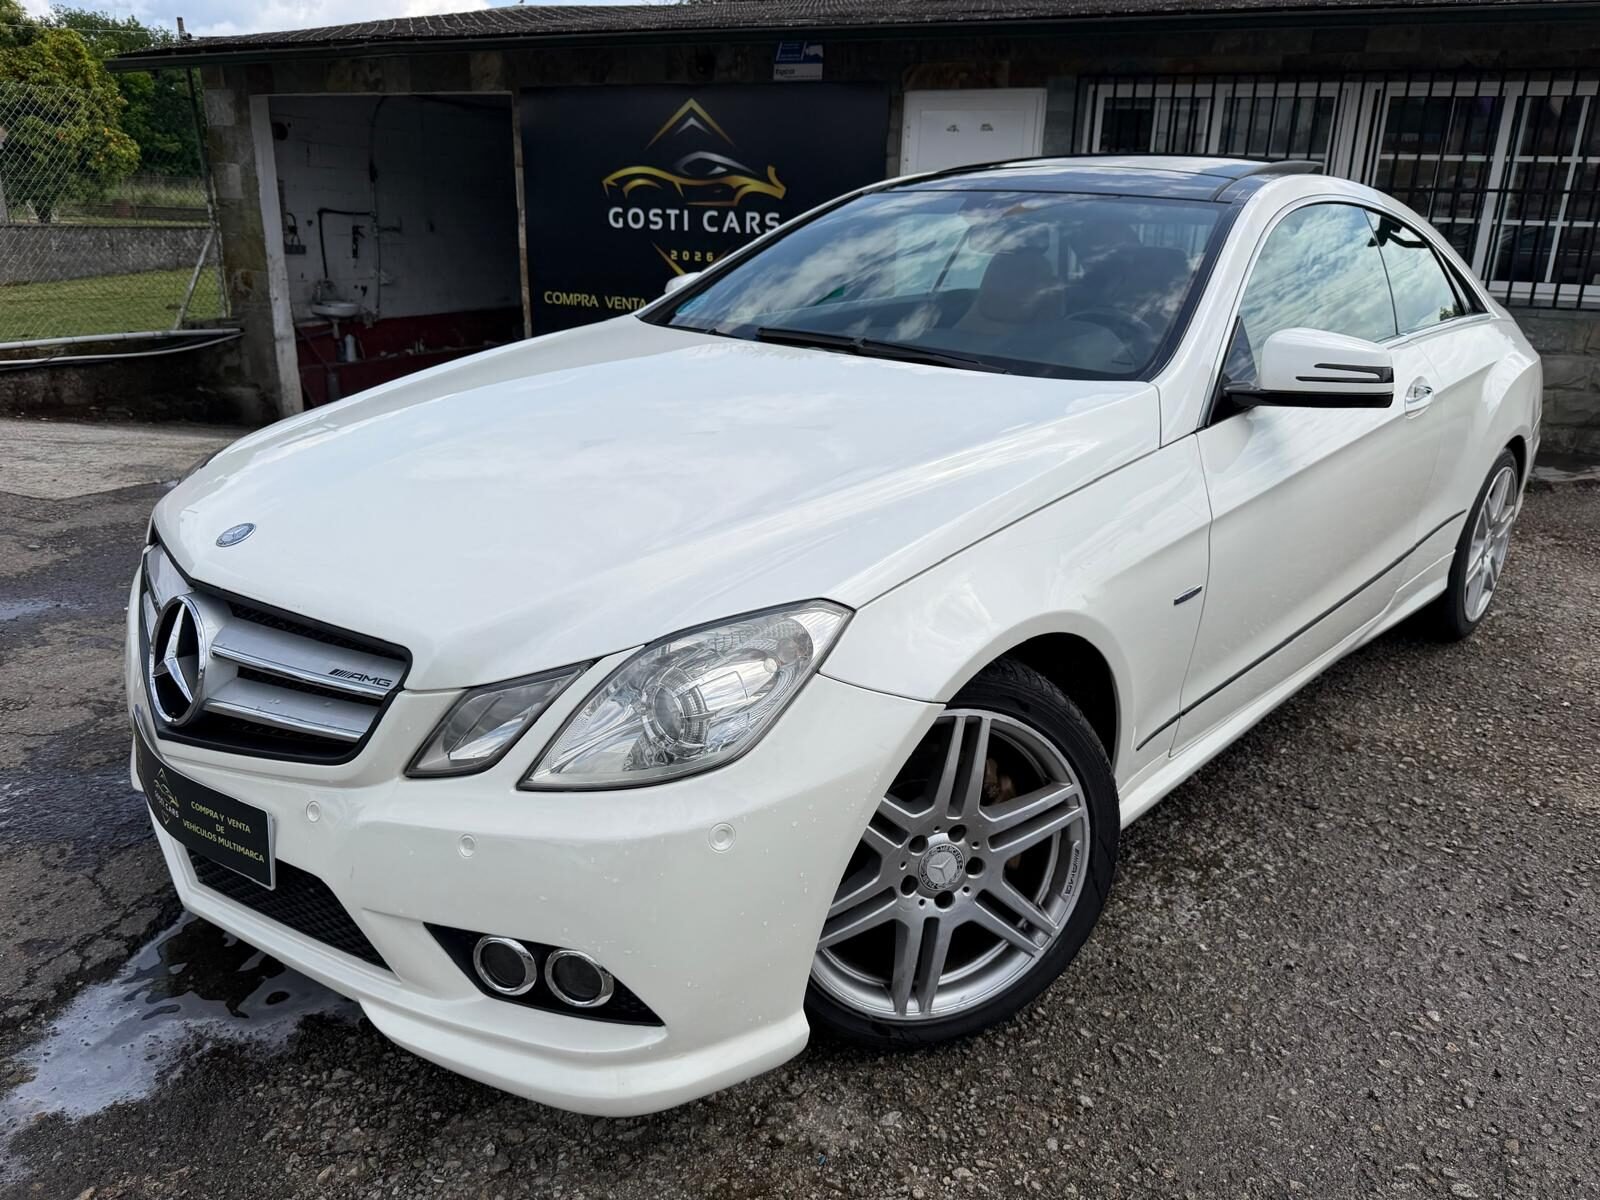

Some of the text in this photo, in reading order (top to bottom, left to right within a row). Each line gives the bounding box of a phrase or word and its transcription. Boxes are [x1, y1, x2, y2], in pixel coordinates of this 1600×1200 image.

[608, 207, 781, 234] GOSTI CARS
[670, 250, 714, 262] 2026
[543, 291, 647, 310] COMPRA VENTA
[190, 801, 219, 820] COMPRA
[219, 813, 225, 822] Y
[227, 816, 251, 834] VENTA
[215, 823, 225, 834] DE
[217, 836, 265, 863] MULTIMARCA
